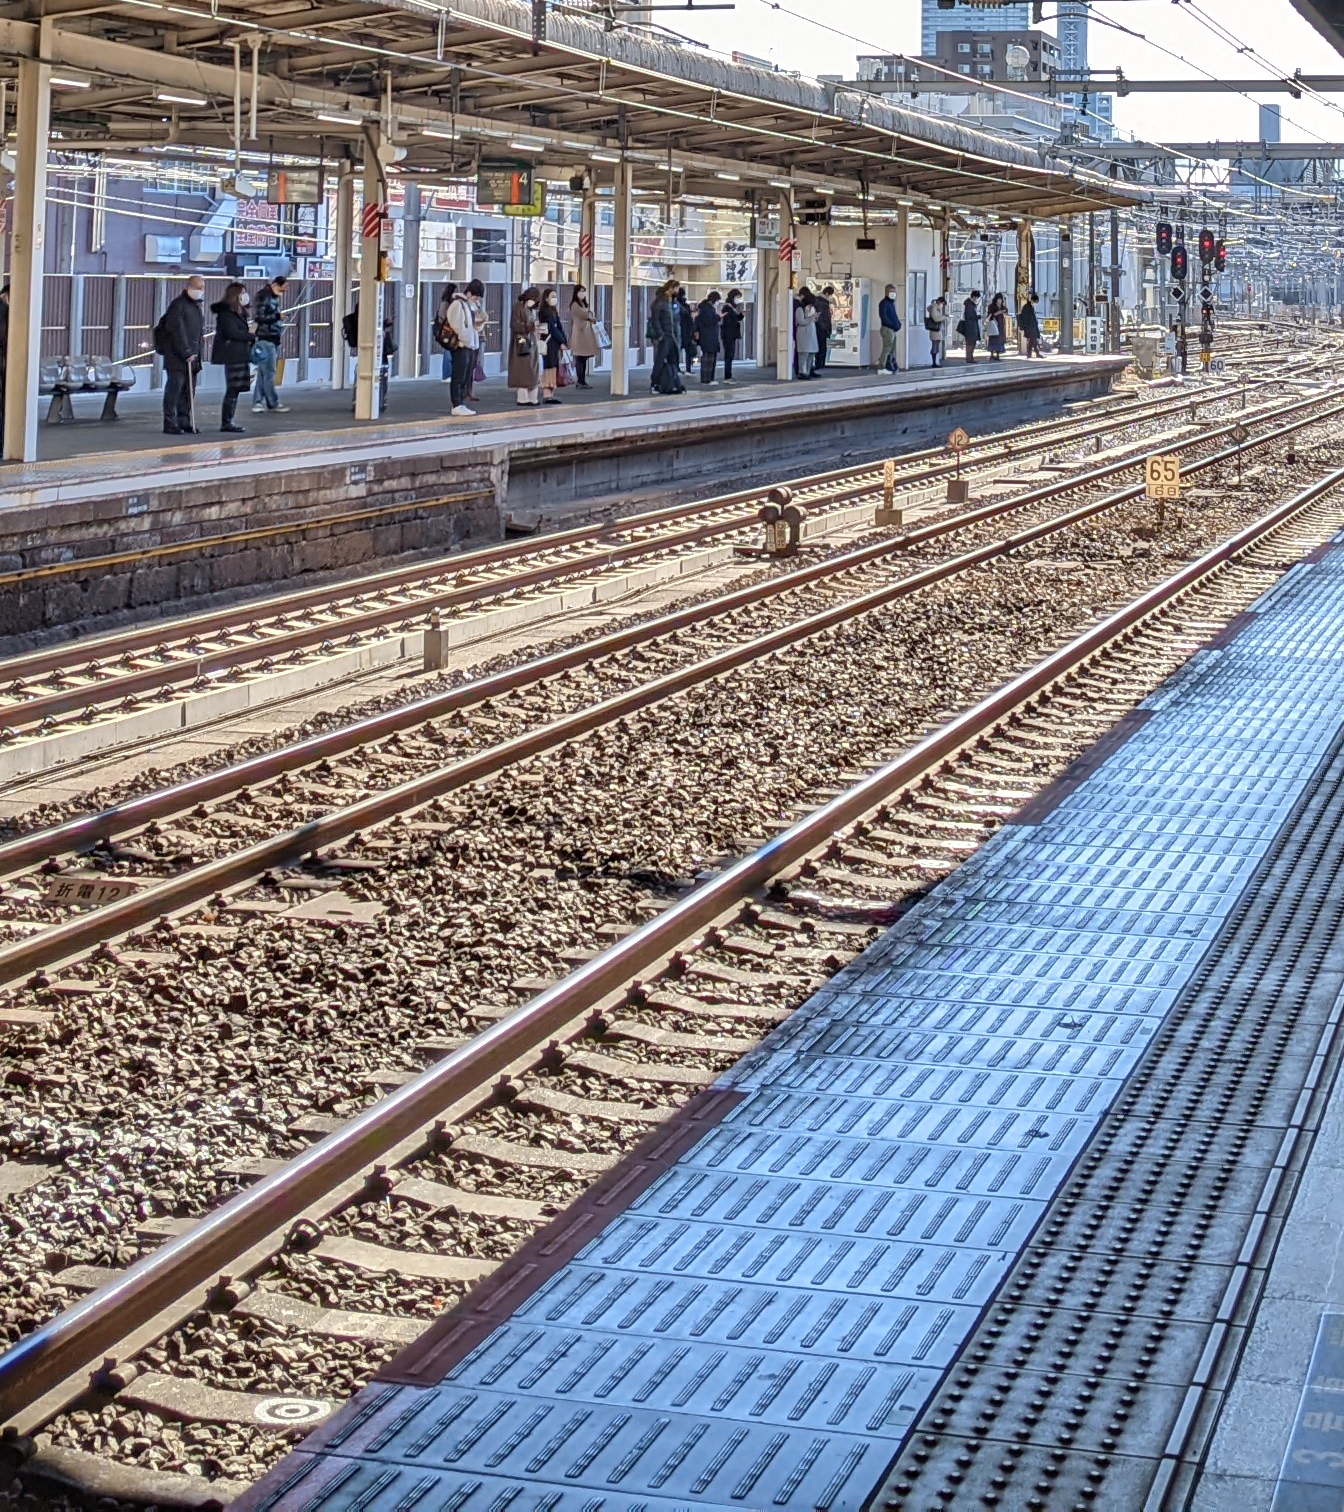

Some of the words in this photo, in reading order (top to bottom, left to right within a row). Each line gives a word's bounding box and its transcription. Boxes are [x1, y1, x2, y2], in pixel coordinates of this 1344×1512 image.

[518, 172, 529, 186] 4
[1210, 360, 1224, 371] 60
[954, 433, 963, 446] 12
[1149, 459, 1176, 482] 65
